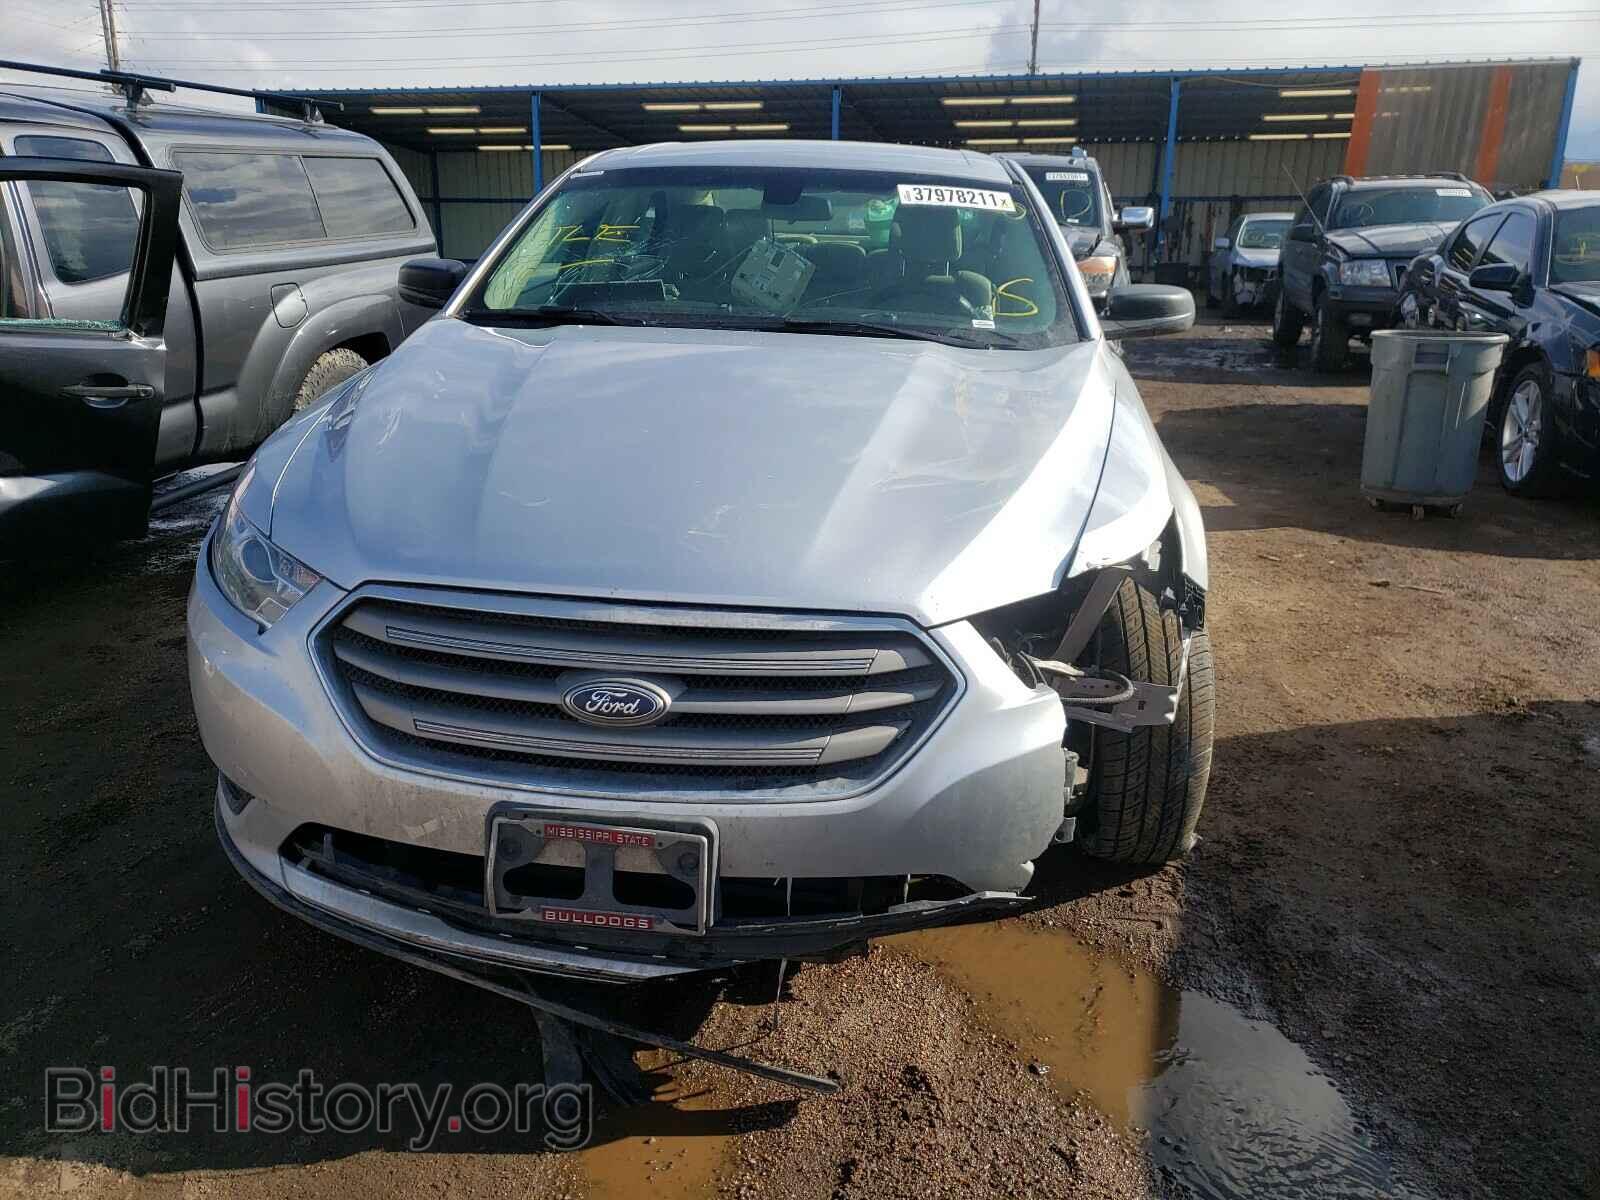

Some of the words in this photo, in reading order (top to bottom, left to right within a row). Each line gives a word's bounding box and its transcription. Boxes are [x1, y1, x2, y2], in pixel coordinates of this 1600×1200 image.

[913, 188, 998, 206] 37978211
[585, 690, 642, 714] Ford
[547, 825, 614, 842] MISSISSIPPI
[616, 832, 650, 847] STATE
[545, 910, 650, 929] BULLDOGS
